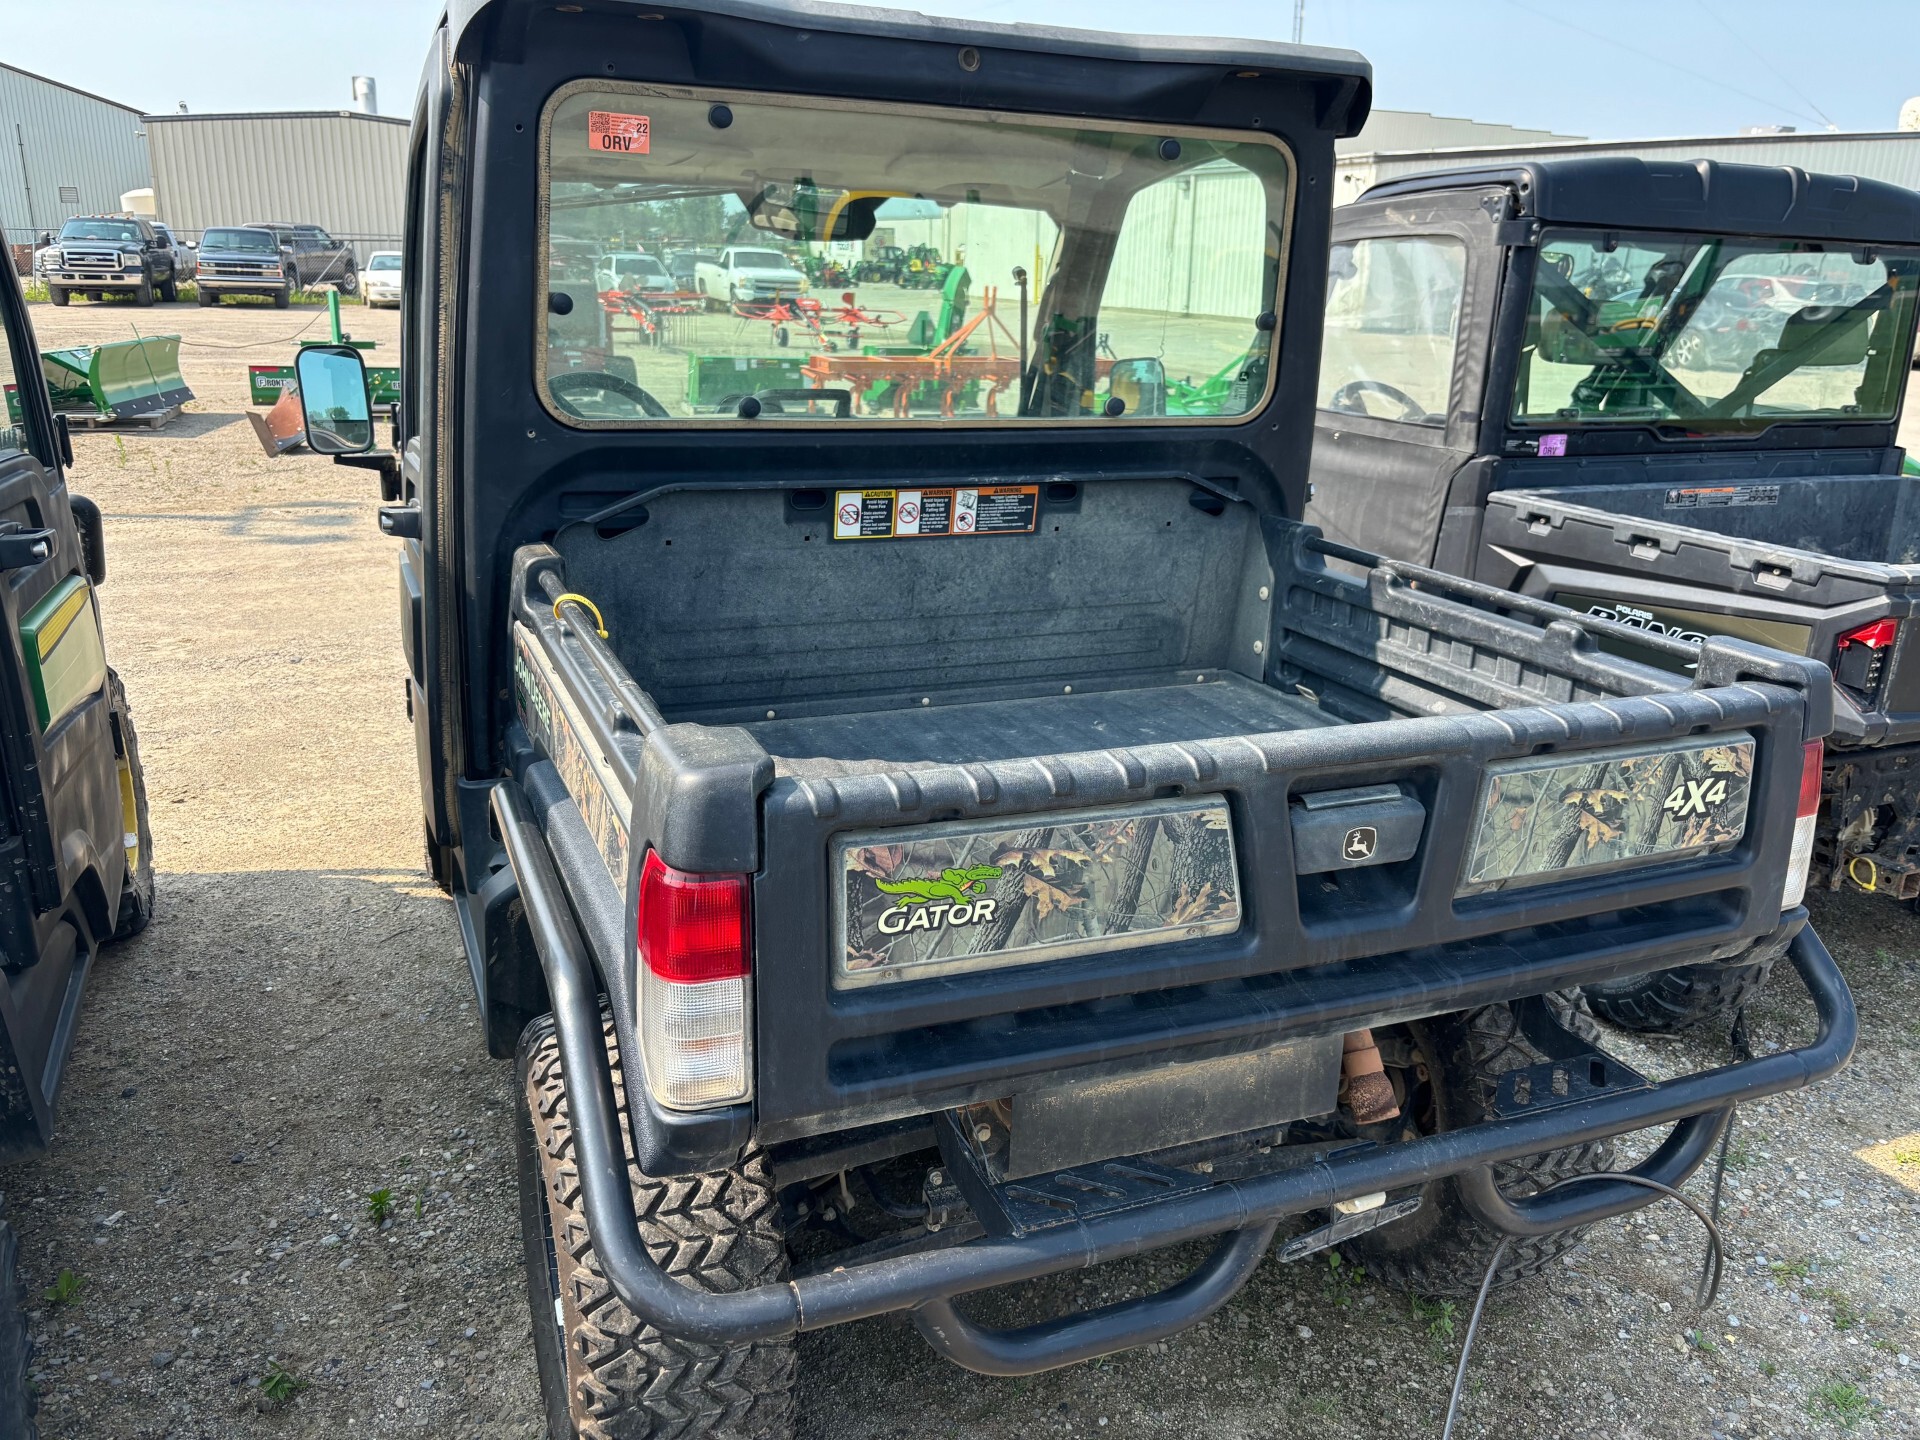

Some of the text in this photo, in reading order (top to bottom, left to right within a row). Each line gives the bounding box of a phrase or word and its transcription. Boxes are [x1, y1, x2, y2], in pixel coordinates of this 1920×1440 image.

[636, 122, 648, 134] 22
[602, 134, 632, 150] ORV
[257, 376, 286, 388] FRONT
[1616, 604, 1653, 620] POLARIS
[515, 645, 550, 736] JOHN DEERE
[1662, 777, 1727, 817] 4X4
[877, 898, 997, 936] GATOR
